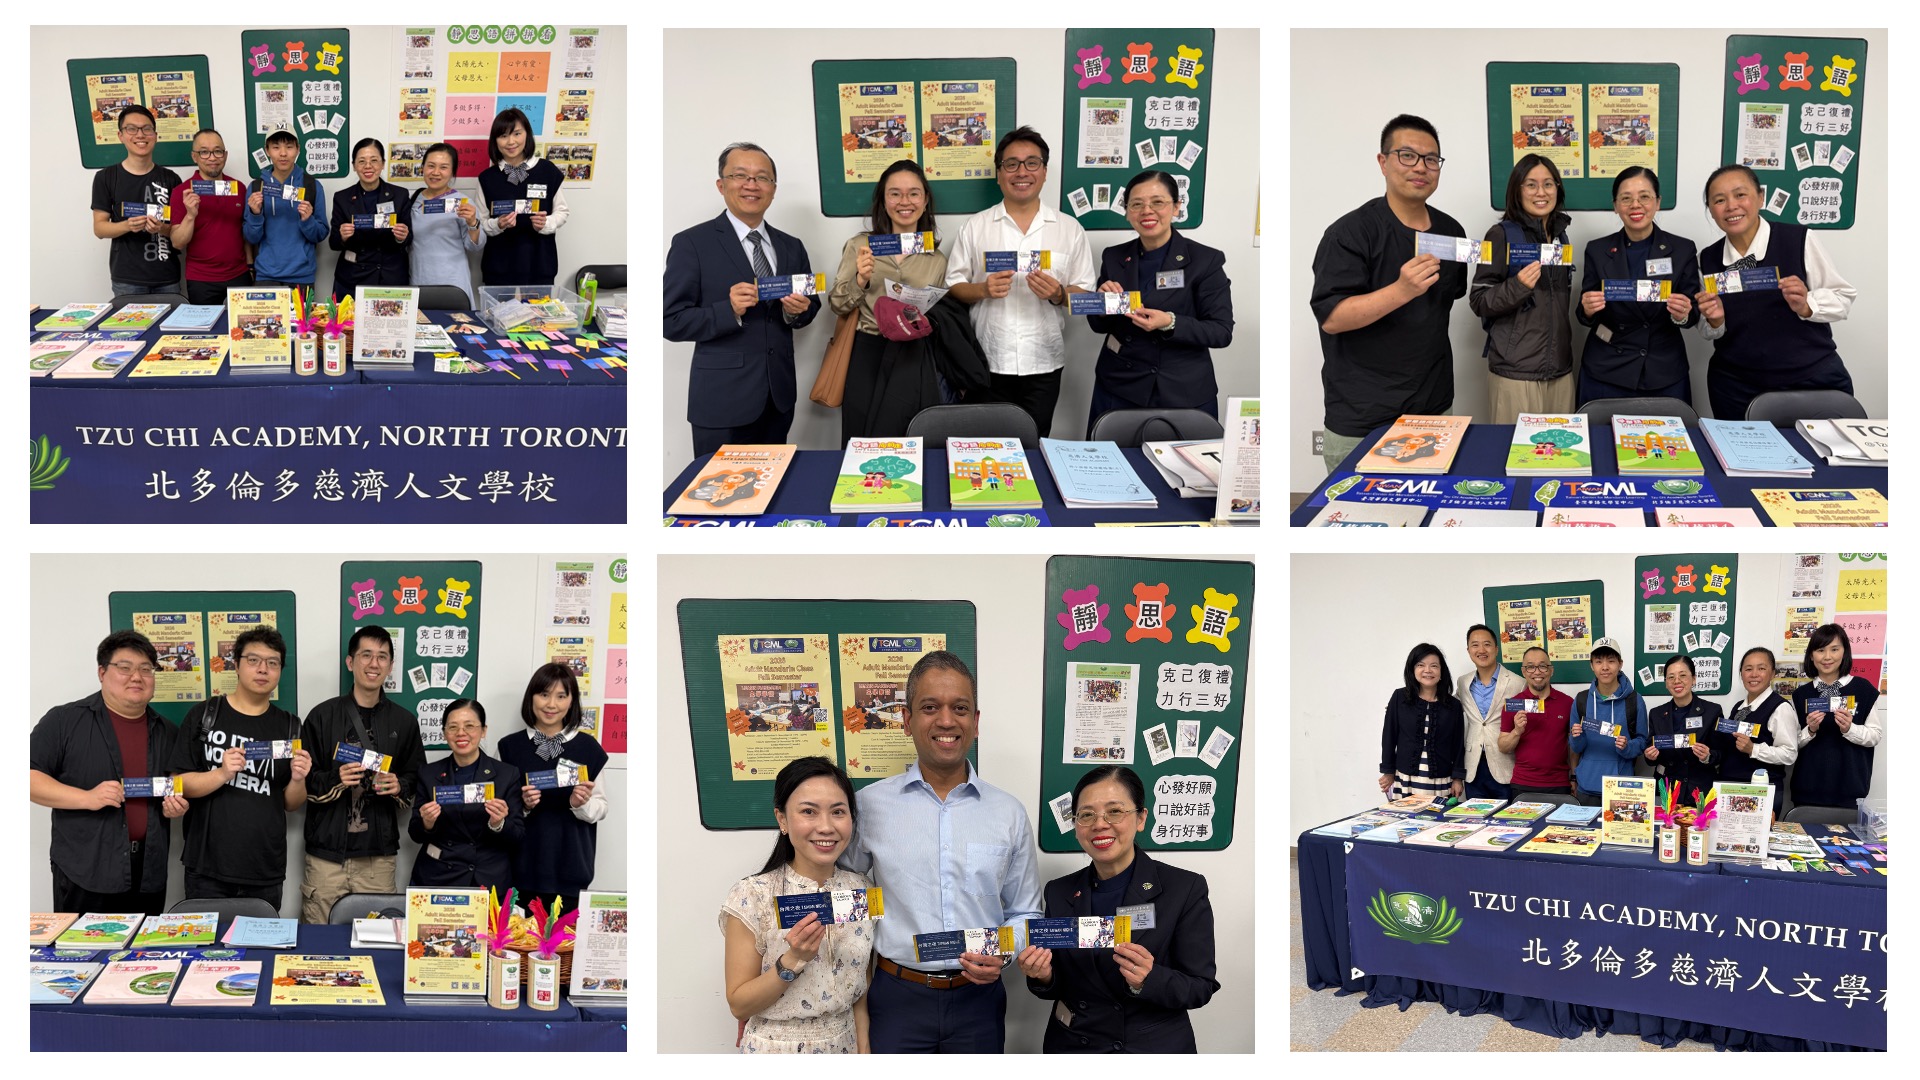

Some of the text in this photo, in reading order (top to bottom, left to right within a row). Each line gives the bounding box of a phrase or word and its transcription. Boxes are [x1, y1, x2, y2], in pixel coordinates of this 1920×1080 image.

[450, 28, 550, 40] 靜思語拼拼看
[256, 51, 336, 68] 靜思語
[1084, 56, 1196, 78] 靜思語
[1744, 65, 1848, 86] 靜思語
[304, 83, 340, 92] 克己復禮
[305, 95, 340, 104] 力行三好
[1148, 100, 1198, 112] 克己復禮
[1804, 106, 1851, 118] 克己復禮
[1148, 116, 1198, 128] 力行三好
[1804, 121, 1850, 133] 力行三好
[308, 142, 336, 150] 心發好願
[308, 152, 336, 160] 口說好話
[308, 164, 336, 172] 身行好事
[1802, 181, 1840, 191] 心發好願
[1802, 196, 1839, 206] 口說好話
[1800, 210, 1838, 221] 身行好事
[76, 426, 627, 449] TZU CHI ACADEMY, NORTH TORONT
[145, 467, 558, 503] 北多倫多慈濟人文學校
[1364, 478, 1444, 494] TCML
[1563, 482, 1648, 496] TCML
[1648, 574, 1724, 592] 靜思語
[358, 588, 463, 610] 靜思語
[1692, 604, 1727, 612] 克己復禮
[1073, 602, 1226, 636] 靜思語
[1691, 615, 1726, 624] 力行三好
[420, 628, 466, 640] 克己復禮
[420, 644, 466, 655] 力行三好
[761, 640, 782, 648] TCML
[880, 639, 902, 648] TCML
[1162, 668, 1230, 686] 克己復禮
[1161, 691, 1228, 708] 力行三好
[420, 703, 448, 712] 心發好
[1158, 780, 1212, 796] 心發好願
[1158, 802, 1210, 817] 口說好話
[1156, 824, 1208, 838] 身行好事
[1469, 890, 1516, 913] TZU
[1524, 896, 1572, 920] CHI
[1578, 901, 1726, 938] ACADEMY,
[1735, 916, 1848, 950] NORTH
